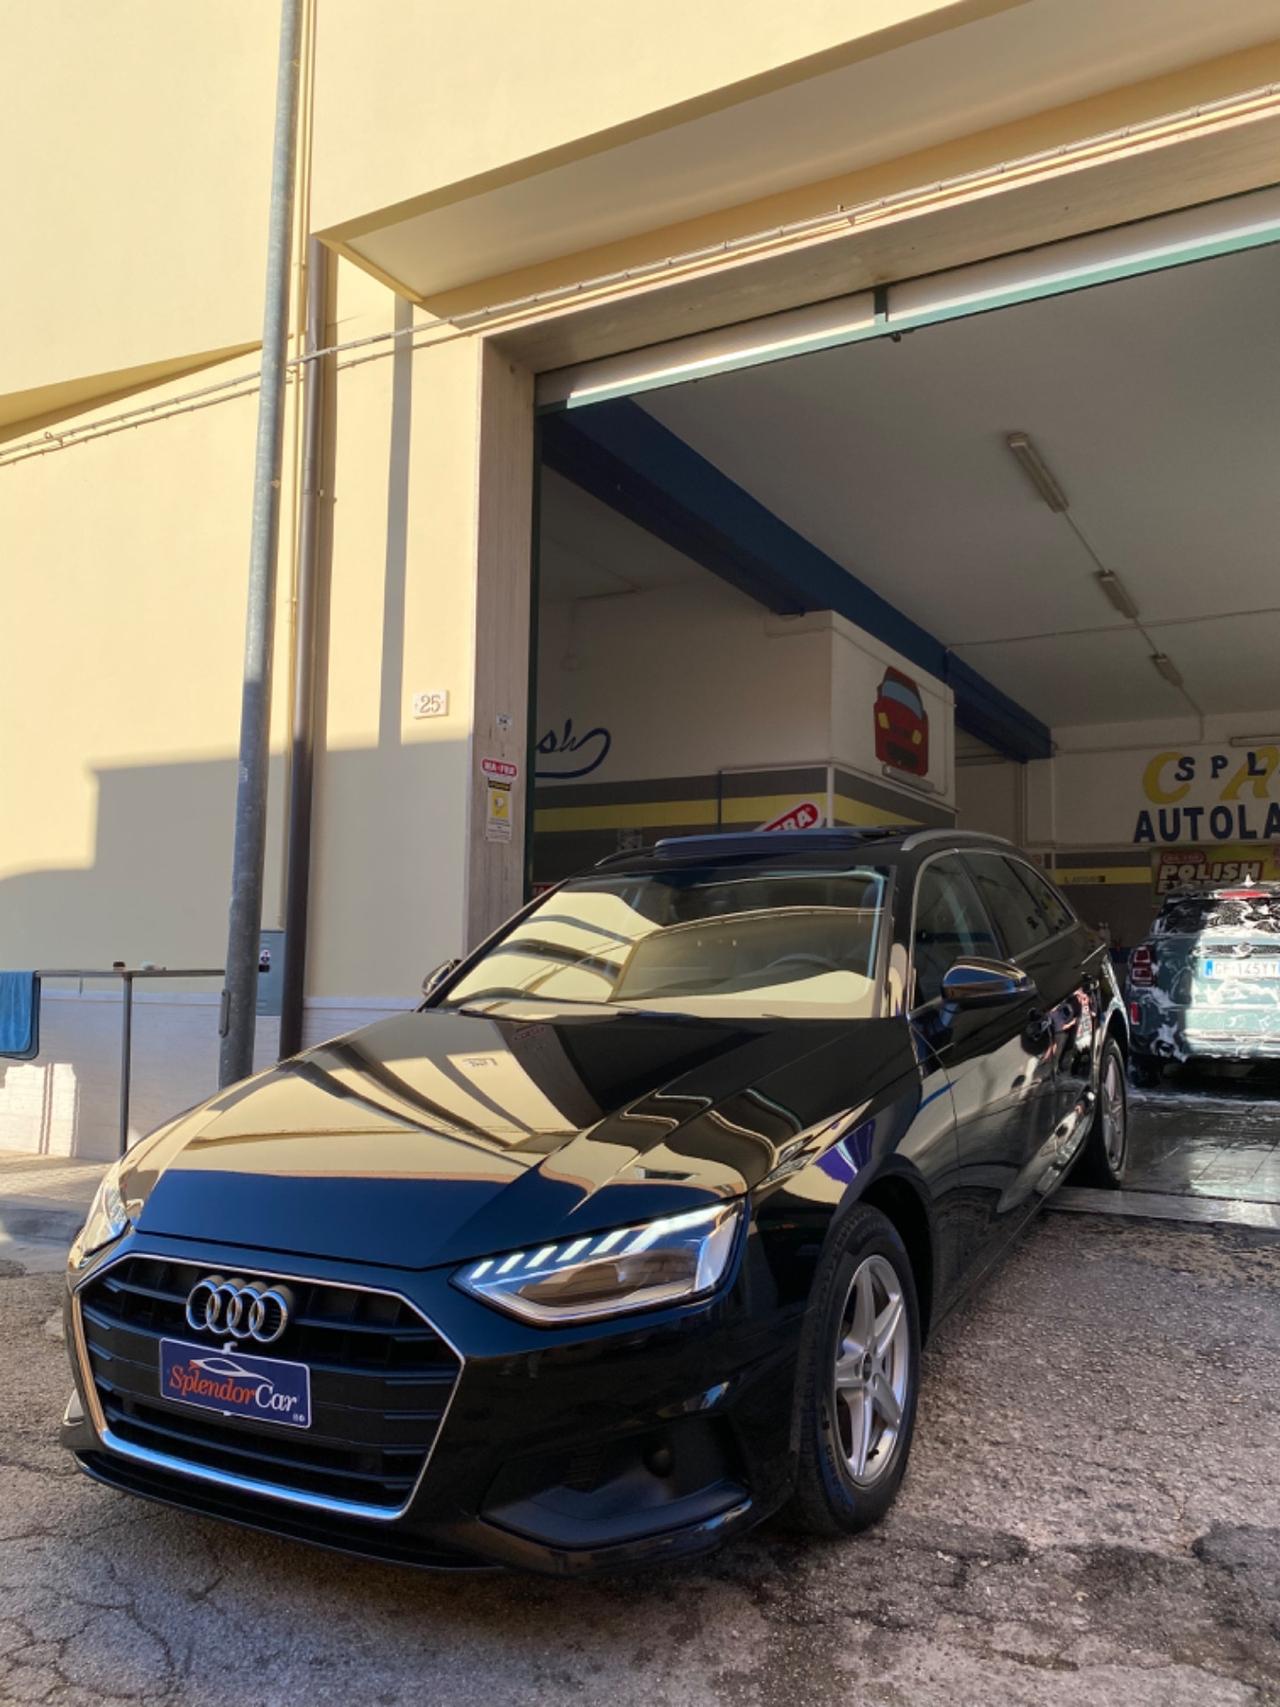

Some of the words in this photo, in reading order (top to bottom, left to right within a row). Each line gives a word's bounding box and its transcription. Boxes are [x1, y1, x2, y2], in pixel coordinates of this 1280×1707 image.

[419, 693, 441, 714] 25
[1174, 751, 1280, 781] SPL
[1133, 803, 1280, 843] AUTOLA
[1158, 861, 1262, 881] POLISH
